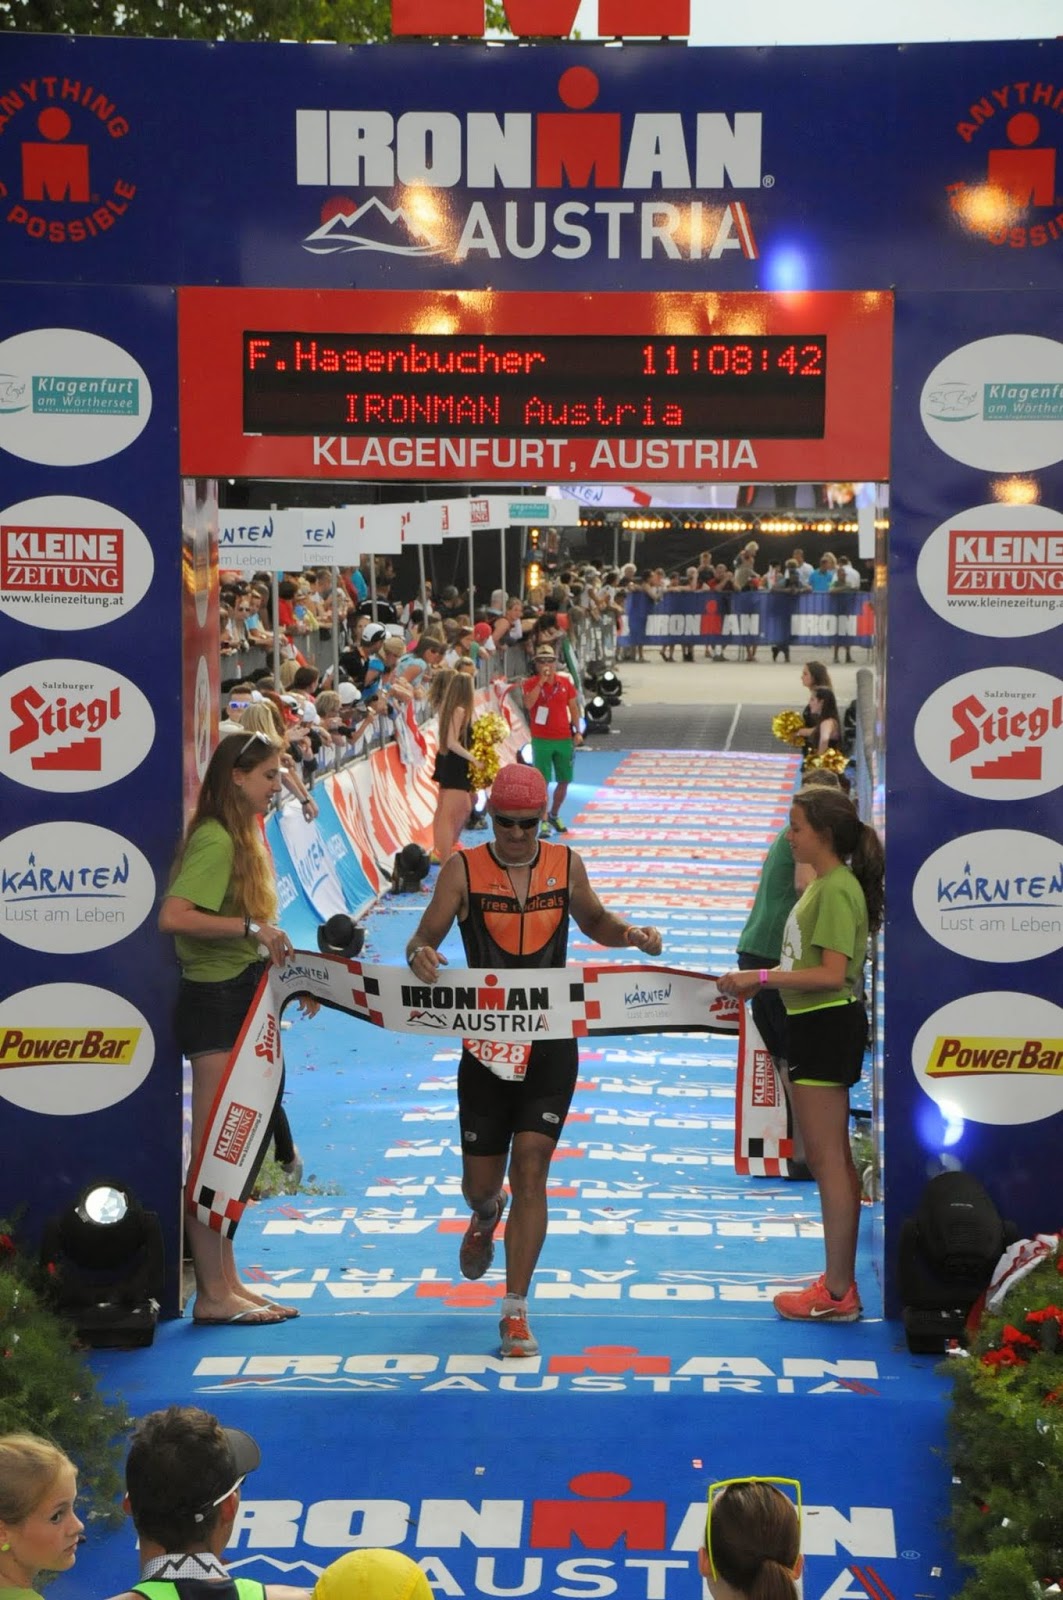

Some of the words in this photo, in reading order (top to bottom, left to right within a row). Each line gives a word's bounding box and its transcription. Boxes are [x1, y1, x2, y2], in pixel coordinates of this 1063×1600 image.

[956, 81, 1063, 143] ANYTHI
[296, 109, 763, 189] IRONMAN
[7, 179, 137, 243] POSSIBLE
[456, 201, 759, 259] AUSTRIA
[643, 344, 822, 375] 11:08:42
[38, 378, 133, 396] Klagenfurt
[37, 397, 56, 406] am
[346, 394, 500, 424] IRONMAN
[525, 396, 684, 426] Austria
[988, 403, 1006, 413] am
[1013, 402, 1063, 413] Wörther
[313, 436, 576, 472] KLAGENFURT,
[590, 439, 758, 469] AUSTRIA
[7, 532, 117, 561] KLEINE
[955, 536, 1063, 563] KLEINE
[236, 554, 272, 566] Leben
[7, 565, 119, 588] ZEITUNG
[953, 570, 1063, 590] ZEITUNG
[0, 593, 124, 608] www.kleinezeitung.at
[646, 611, 760, 637] IRONMAN
[790, 611, 874, 637] IRONM
[42, 681, 95, 691] Salzburger
[984, 690, 1037, 700] Salzburger
[10, 685, 121, 754] Stiegl
[950, 694, 1063, 763] Stiegl
[5, 906, 38, 922] Lust
[44, 909, 70, 922] am
[76, 907, 125, 923] Leben
[940, 916, 974, 931] Lust
[980, 919, 1005, 931] am
[1011, 916, 1061, 932] Leben
[401, 984, 549, 1011] IRONMAN
[452, 1013, 549, 1032] AUSTRIA
[0, 1030, 131, 1059] PowerBar
[467, 1039, 525, 1064] 2628
[936, 1039, 1063, 1070] PowerBar
[754, 1052, 765, 1104] KLEINE
[215, 1105, 243, 1158] KLEINE
[229, 1110, 255, 1162] ZEITUNG
[193, 1354, 878, 1379] IRONMAN
[420, 1375, 880, 1396] AUSTRIA
